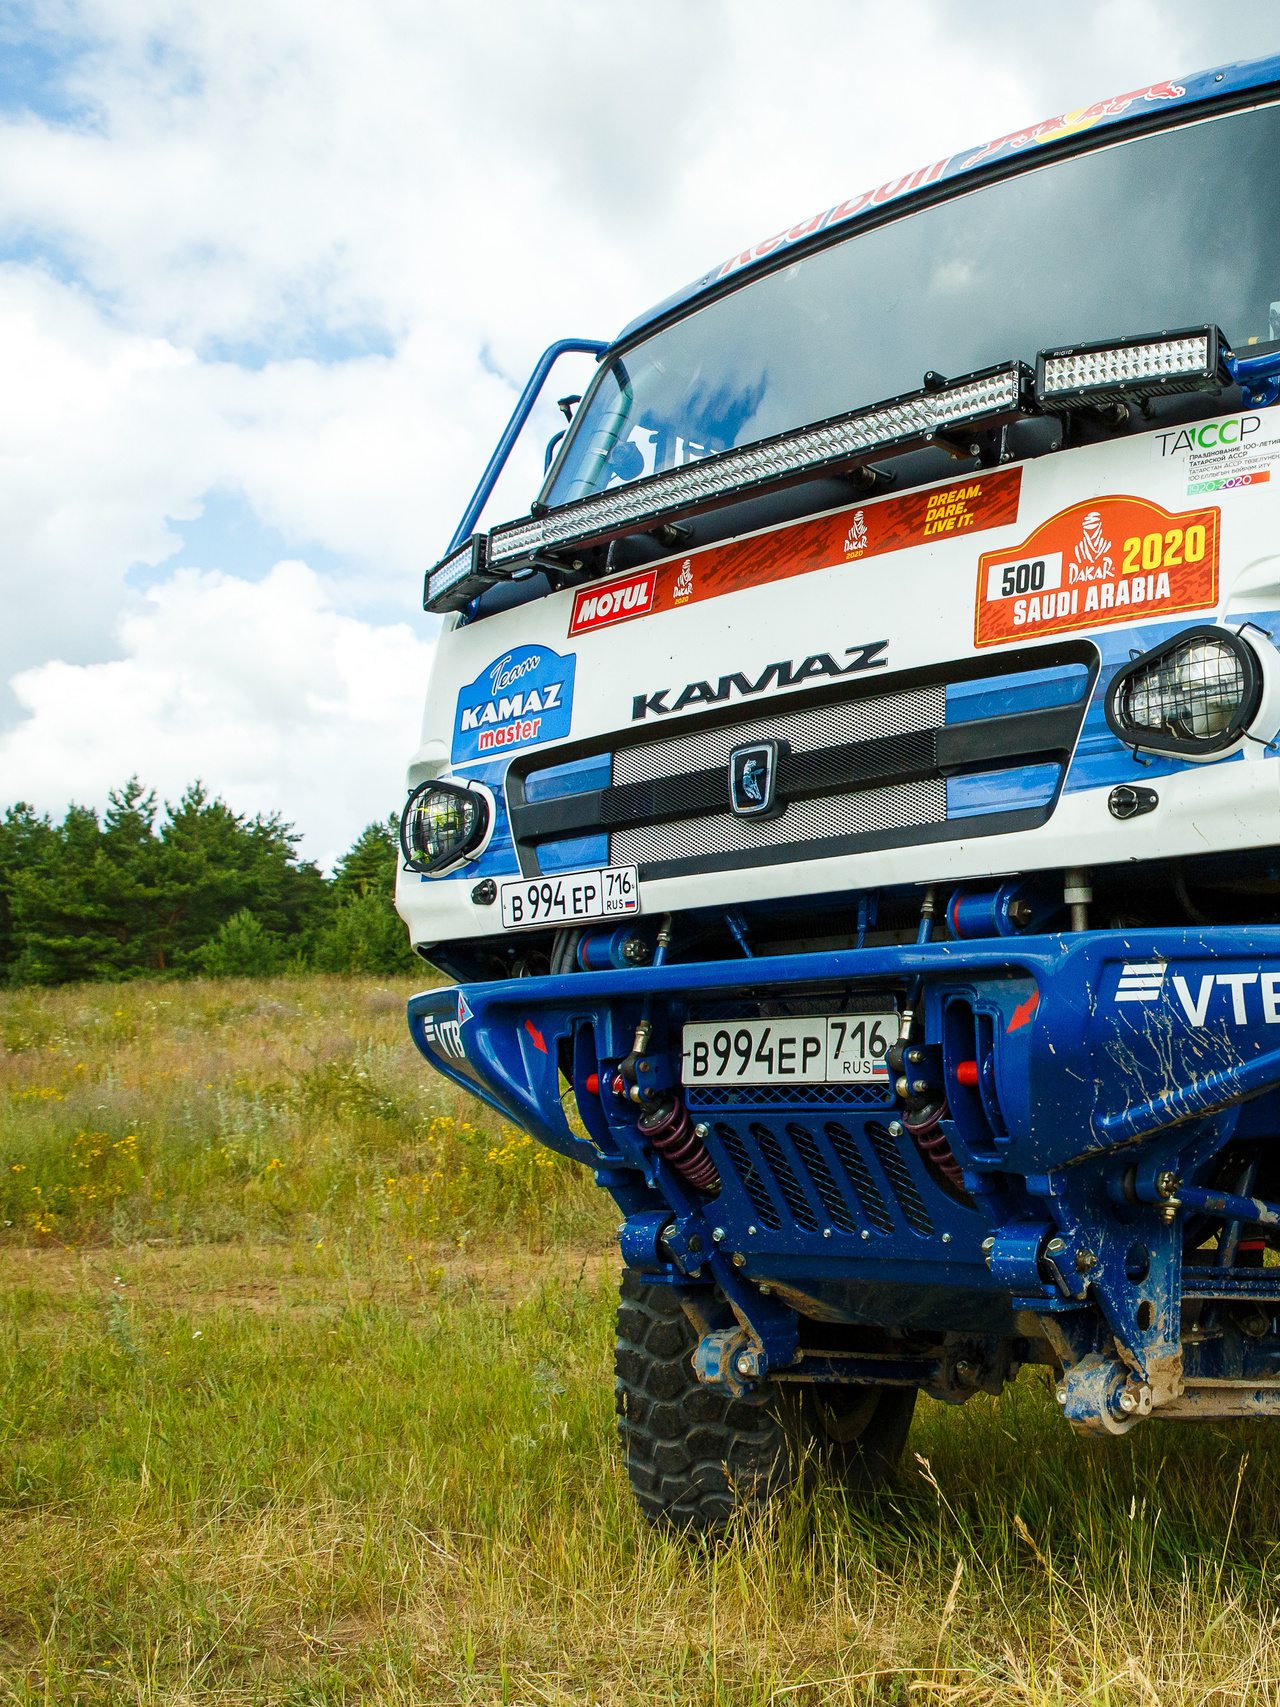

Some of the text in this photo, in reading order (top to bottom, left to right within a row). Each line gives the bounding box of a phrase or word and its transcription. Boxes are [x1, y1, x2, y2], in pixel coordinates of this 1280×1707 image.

[927, 484, 983, 508] DREAM.
[1189, 474, 1252, 495] 1920-2020
[923, 513, 975, 536] LIVE IT.
[925, 501, 968, 523] DARE.
[844, 534, 868, 553] DAKAR
[845, 550, 864, 560] 2020
[1122, 525, 1206, 575] 2020
[1001, 561, 1046, 597] 500
[1067, 556, 1116, 585] DAKAR
[576, 581, 649, 624] MOTUL
[673, 582, 694, 599] DAKAR
[674, 595, 690, 606] 2020
[1013, 572, 1171, 626] SAUDI ARABIA
[489, 654, 541, 696] Team
[632, 638, 890, 722] KAMAZ
[460, 680, 565, 733] KAMAZ
[478, 717, 542, 751] master
[606, 872, 631, 896] 716
[606, 901, 624, 910] RUS
[434, 1020, 466, 1059] VTB
[830, 1021, 888, 1060] 716
[842, 1060, 871, 1075] RUS
